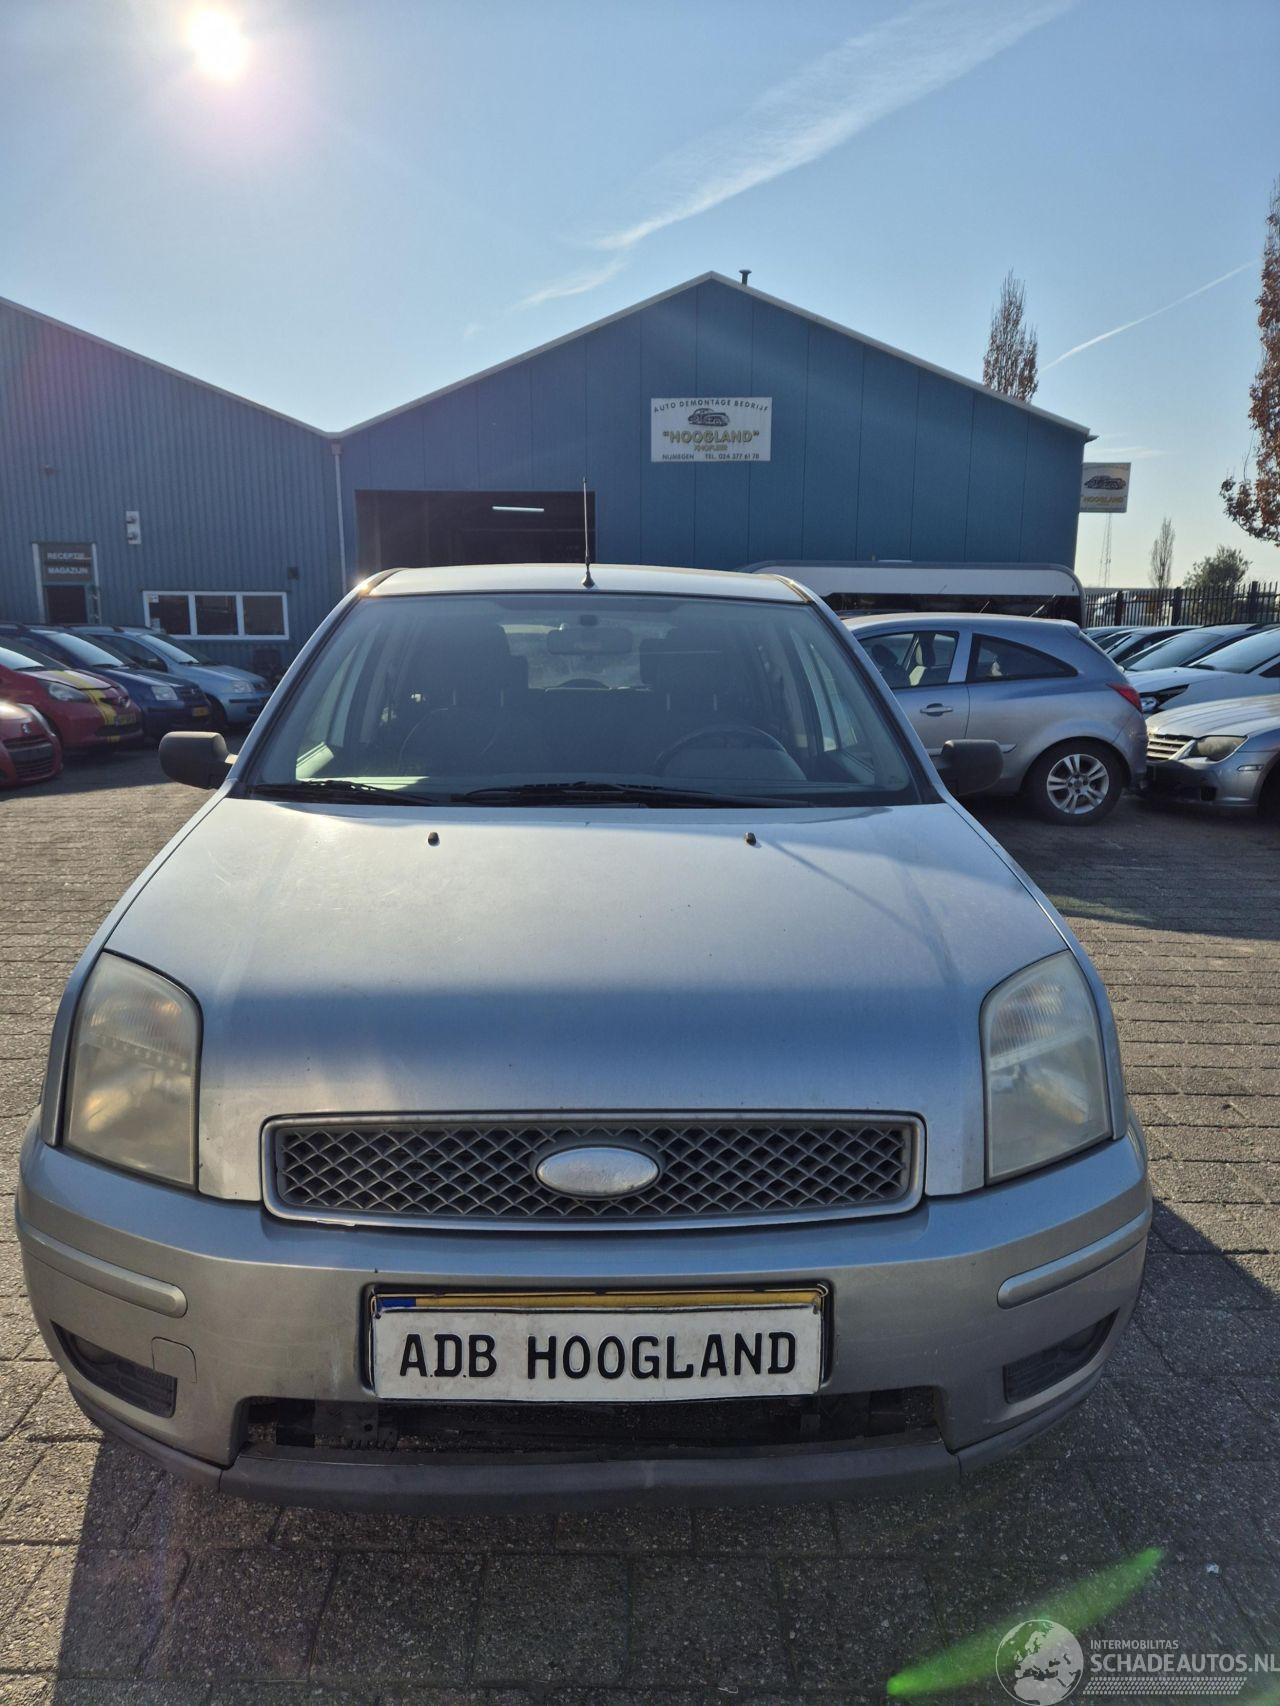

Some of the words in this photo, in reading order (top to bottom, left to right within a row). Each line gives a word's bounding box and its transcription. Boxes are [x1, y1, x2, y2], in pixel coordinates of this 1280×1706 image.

[654, 402, 676, 413] AUTO
[679, 399, 731, 408] DEMONTAGE
[734, 400, 769, 412] BEDRIJF
[662, 453, 694, 461] NIJMEGEN
[527, 1331, 798, 1380] HOOGLAND
